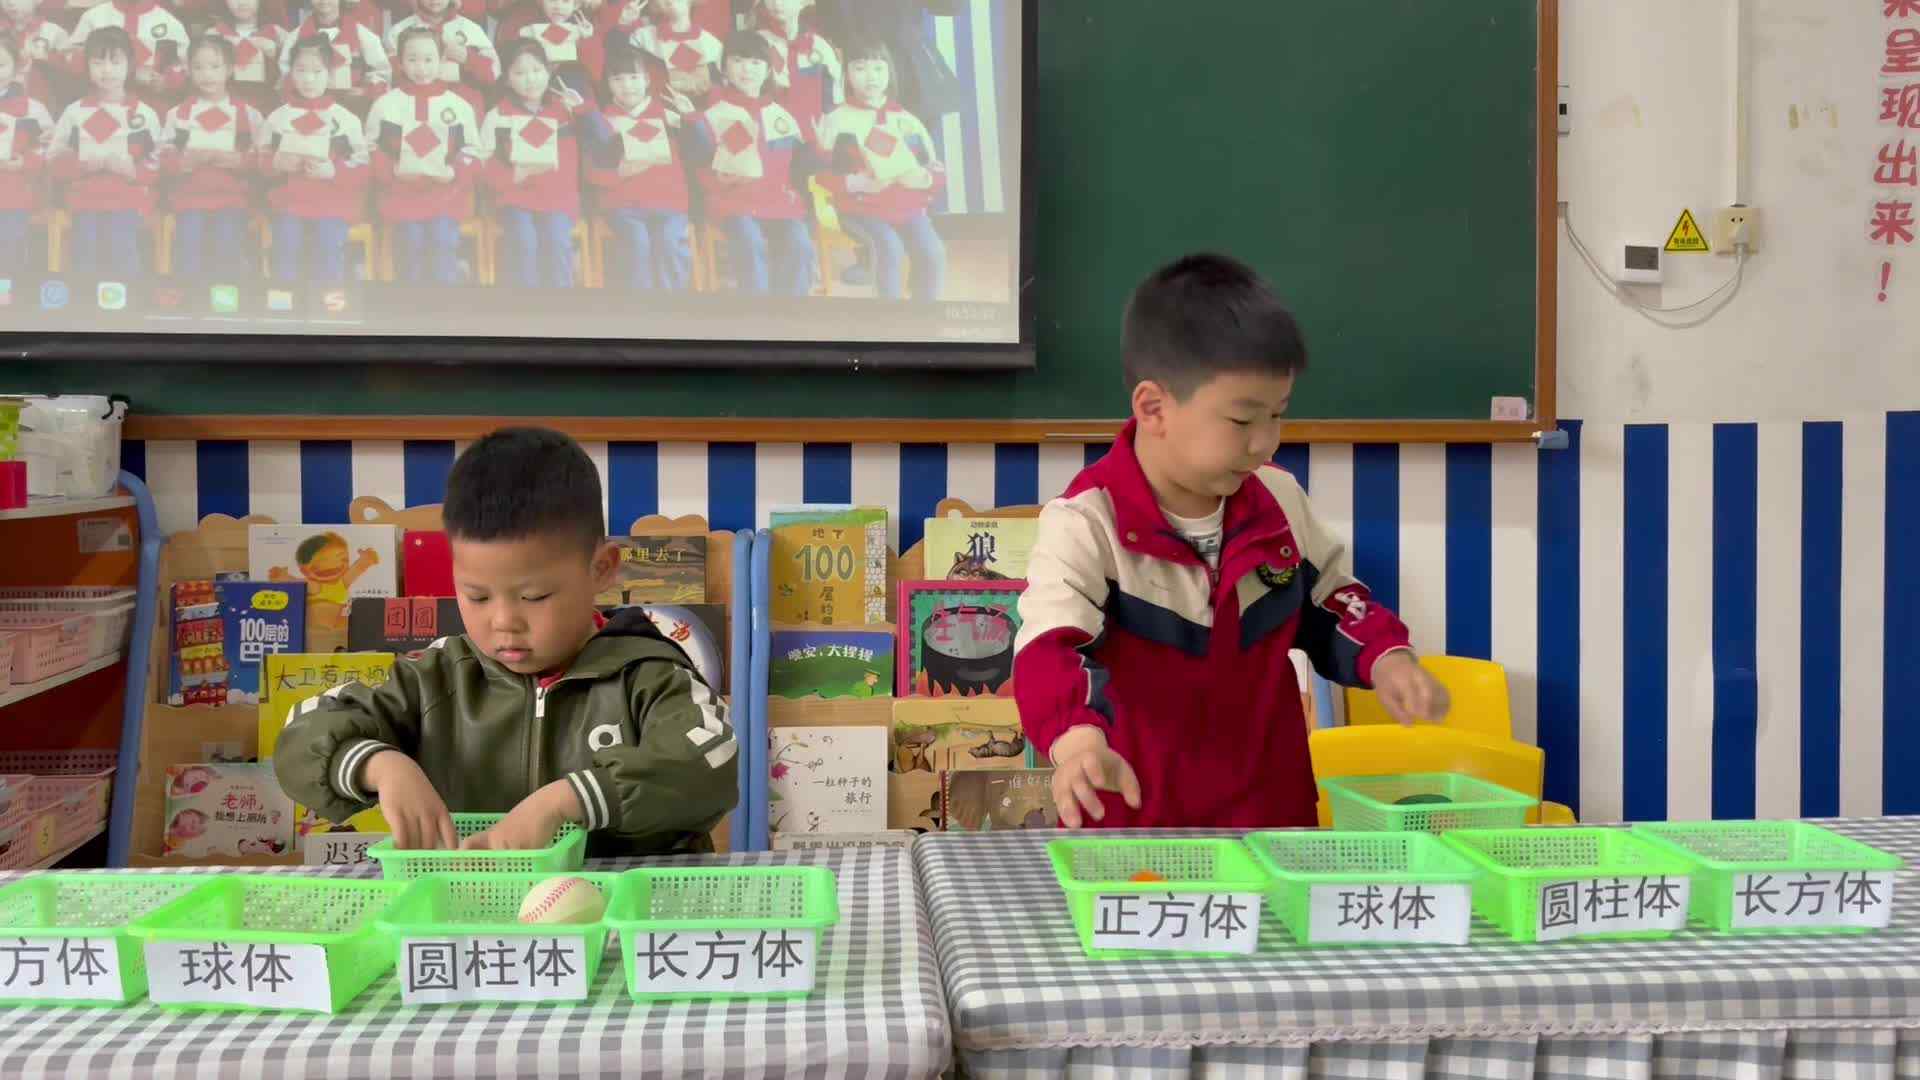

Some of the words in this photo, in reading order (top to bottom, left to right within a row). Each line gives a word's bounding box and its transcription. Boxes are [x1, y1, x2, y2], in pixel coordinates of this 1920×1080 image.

[812, 528, 845, 540] 地下
[966, 531, 997, 564] 狼
[795, 543, 854, 582] 100
[239, 616, 289, 642] 100层的
[845, 792, 873, 805] 旅行
[1094, 891, 1248, 940] 正方体
[1337, 885, 1436, 931] 球体
[1541, 874, 1681, 930] 圆柱体
[1735, 871, 1882, 917] 长方体
[0, 937, 108, 986] 方体
[179, 942, 293, 992] 球体
[407, 937, 576, 993] 圆柱体
[636, 929, 804, 981] 长方体
